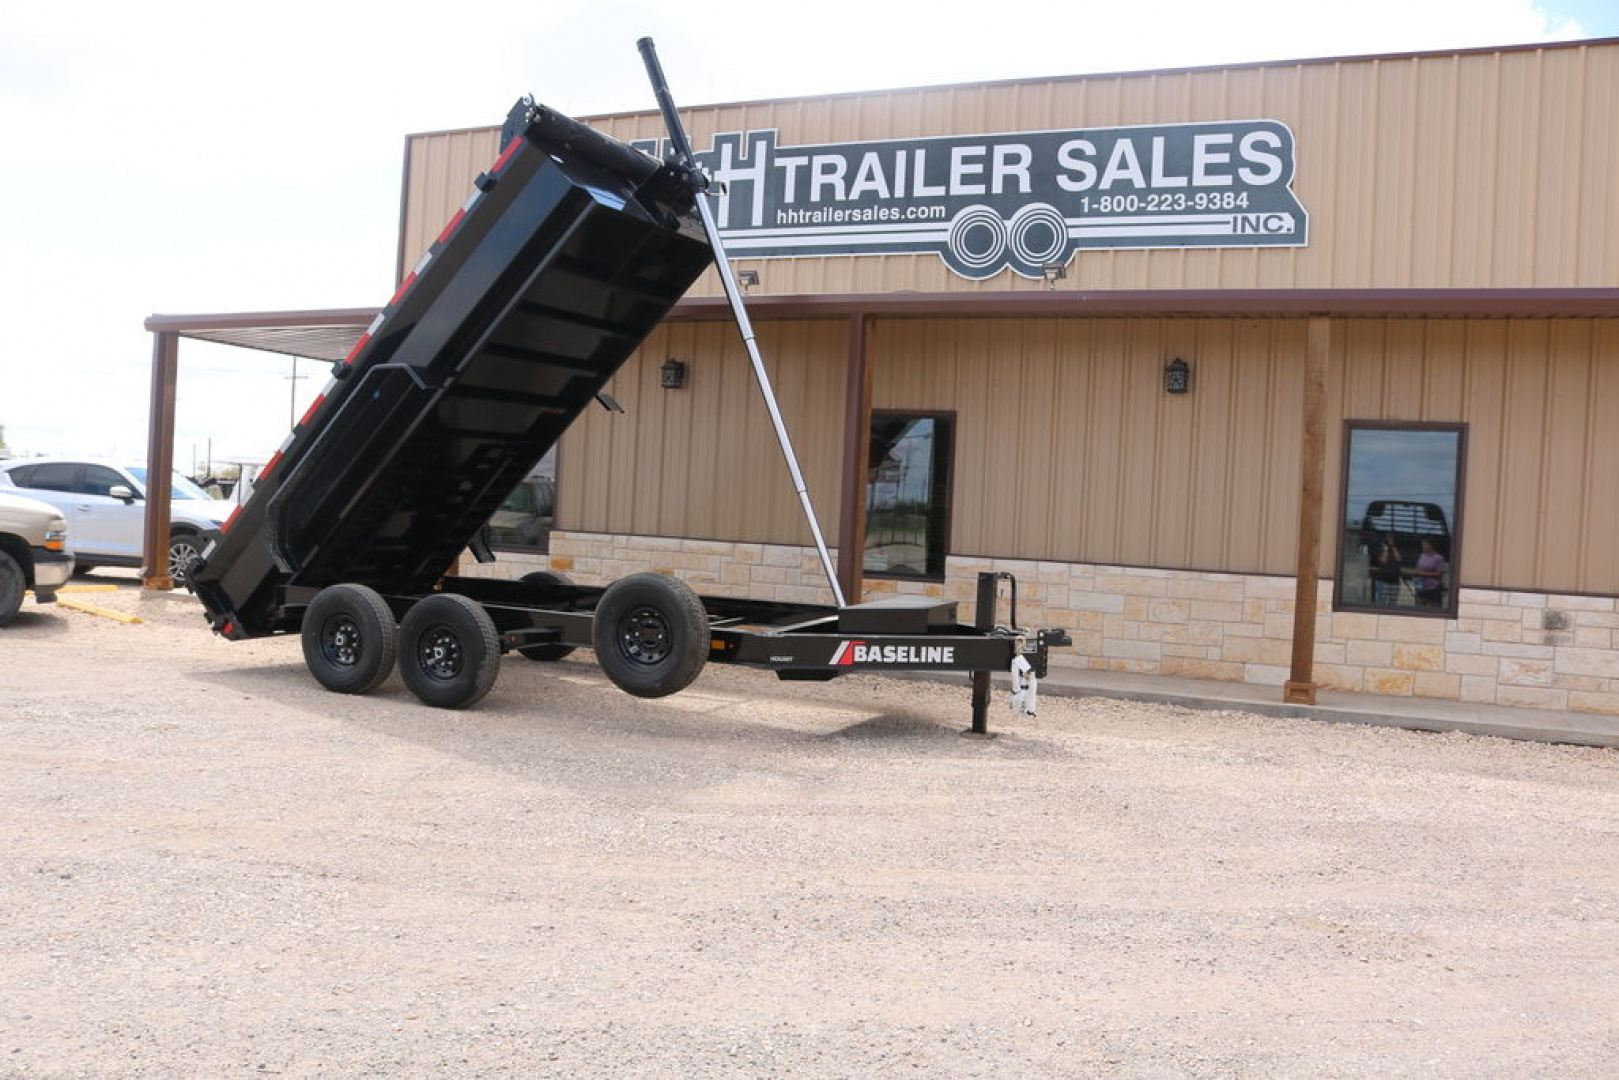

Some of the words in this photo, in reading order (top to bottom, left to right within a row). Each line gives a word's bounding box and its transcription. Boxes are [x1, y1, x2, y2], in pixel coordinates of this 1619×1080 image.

[774, 143, 1032, 203] TRAILER
[1056, 131, 1283, 192] SALES
[1080, 191, 1250, 213] 1-800-223-9384
[776, 205, 946, 224] hhtrailersales.com
[1232, 214, 1293, 234] INC.
[853, 645, 955, 664] BASELINE
